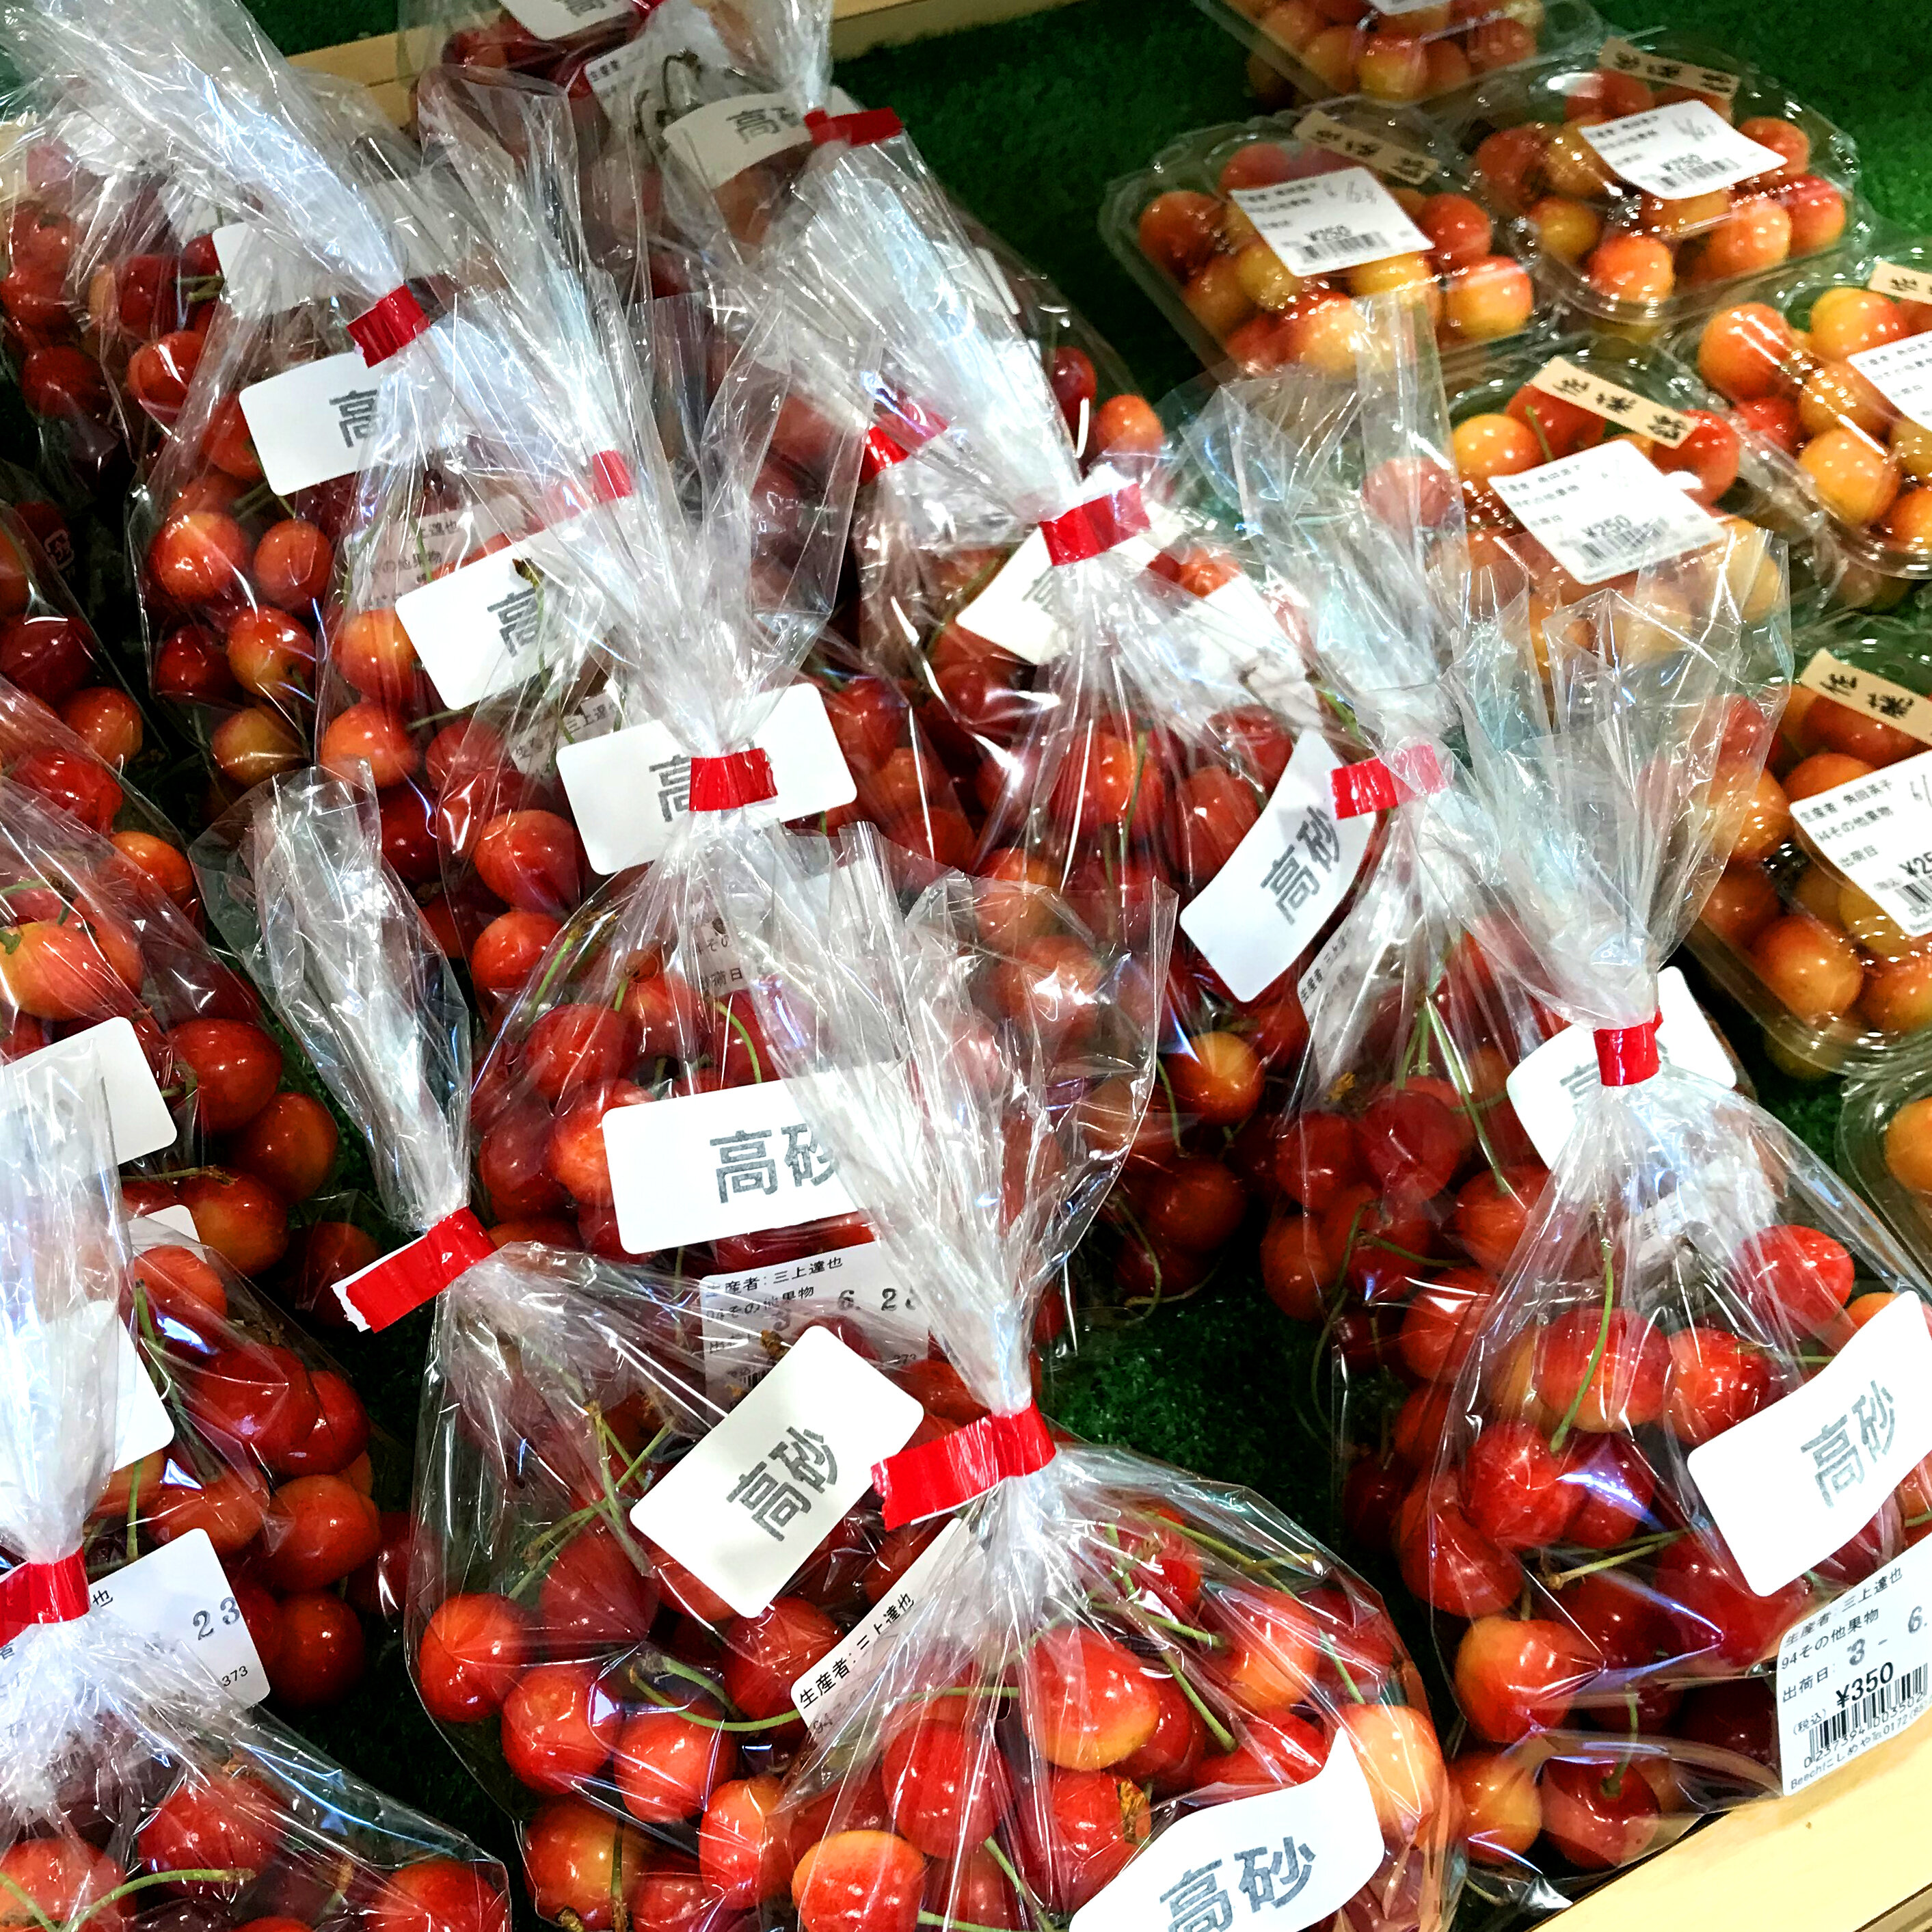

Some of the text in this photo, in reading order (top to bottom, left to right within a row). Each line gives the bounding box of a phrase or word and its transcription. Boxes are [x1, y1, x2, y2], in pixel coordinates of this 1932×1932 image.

[1260, 805, 1339, 926] 高砂
[710, 1123, 837, 1204] 高砂
[726, 1426, 837, 1542] 高砂
[1801, 1380, 1895, 1508] 高砂
[222, 1665, 248, 1687] 373
[1782, 1608, 1879, 1669] 94その他果物
[1836, 1662, 1894, 1708] ¥350
[1159, 1836, 1316, 1932] 高砂
